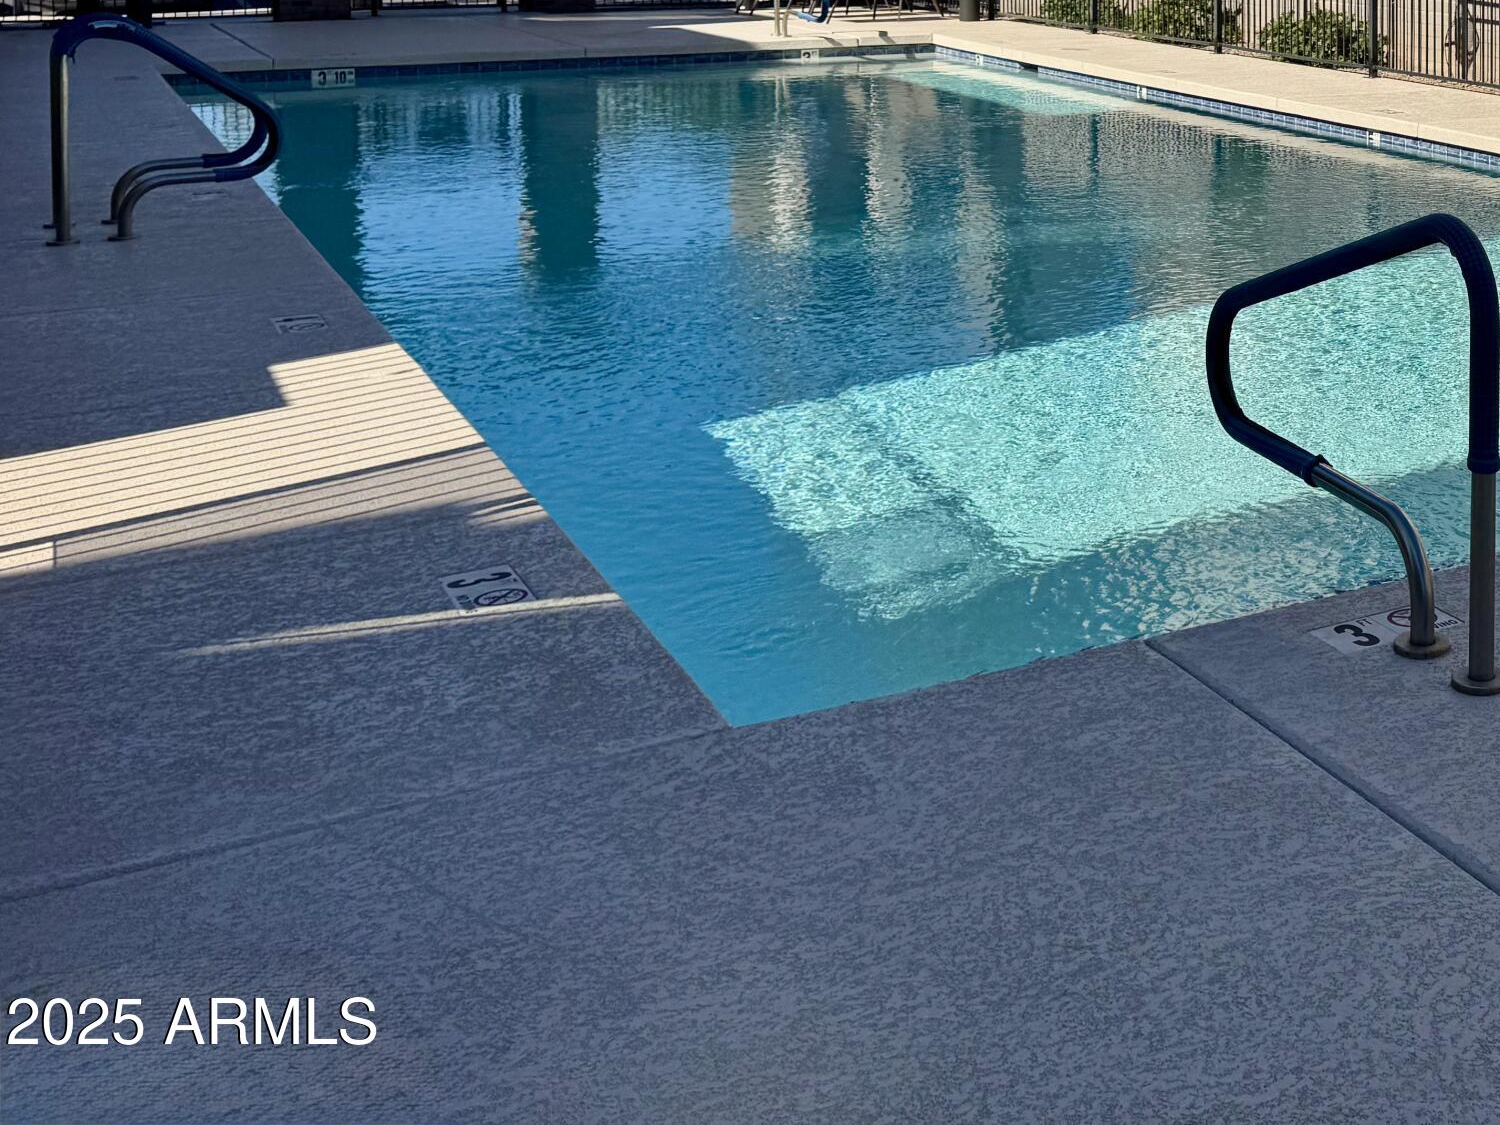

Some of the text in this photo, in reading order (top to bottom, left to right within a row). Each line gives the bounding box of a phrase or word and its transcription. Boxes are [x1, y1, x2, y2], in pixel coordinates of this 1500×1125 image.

[318, 71, 327, 85] 3
[335, 70, 347, 85] 10
[1333, 618, 1381, 647] 3 FT
